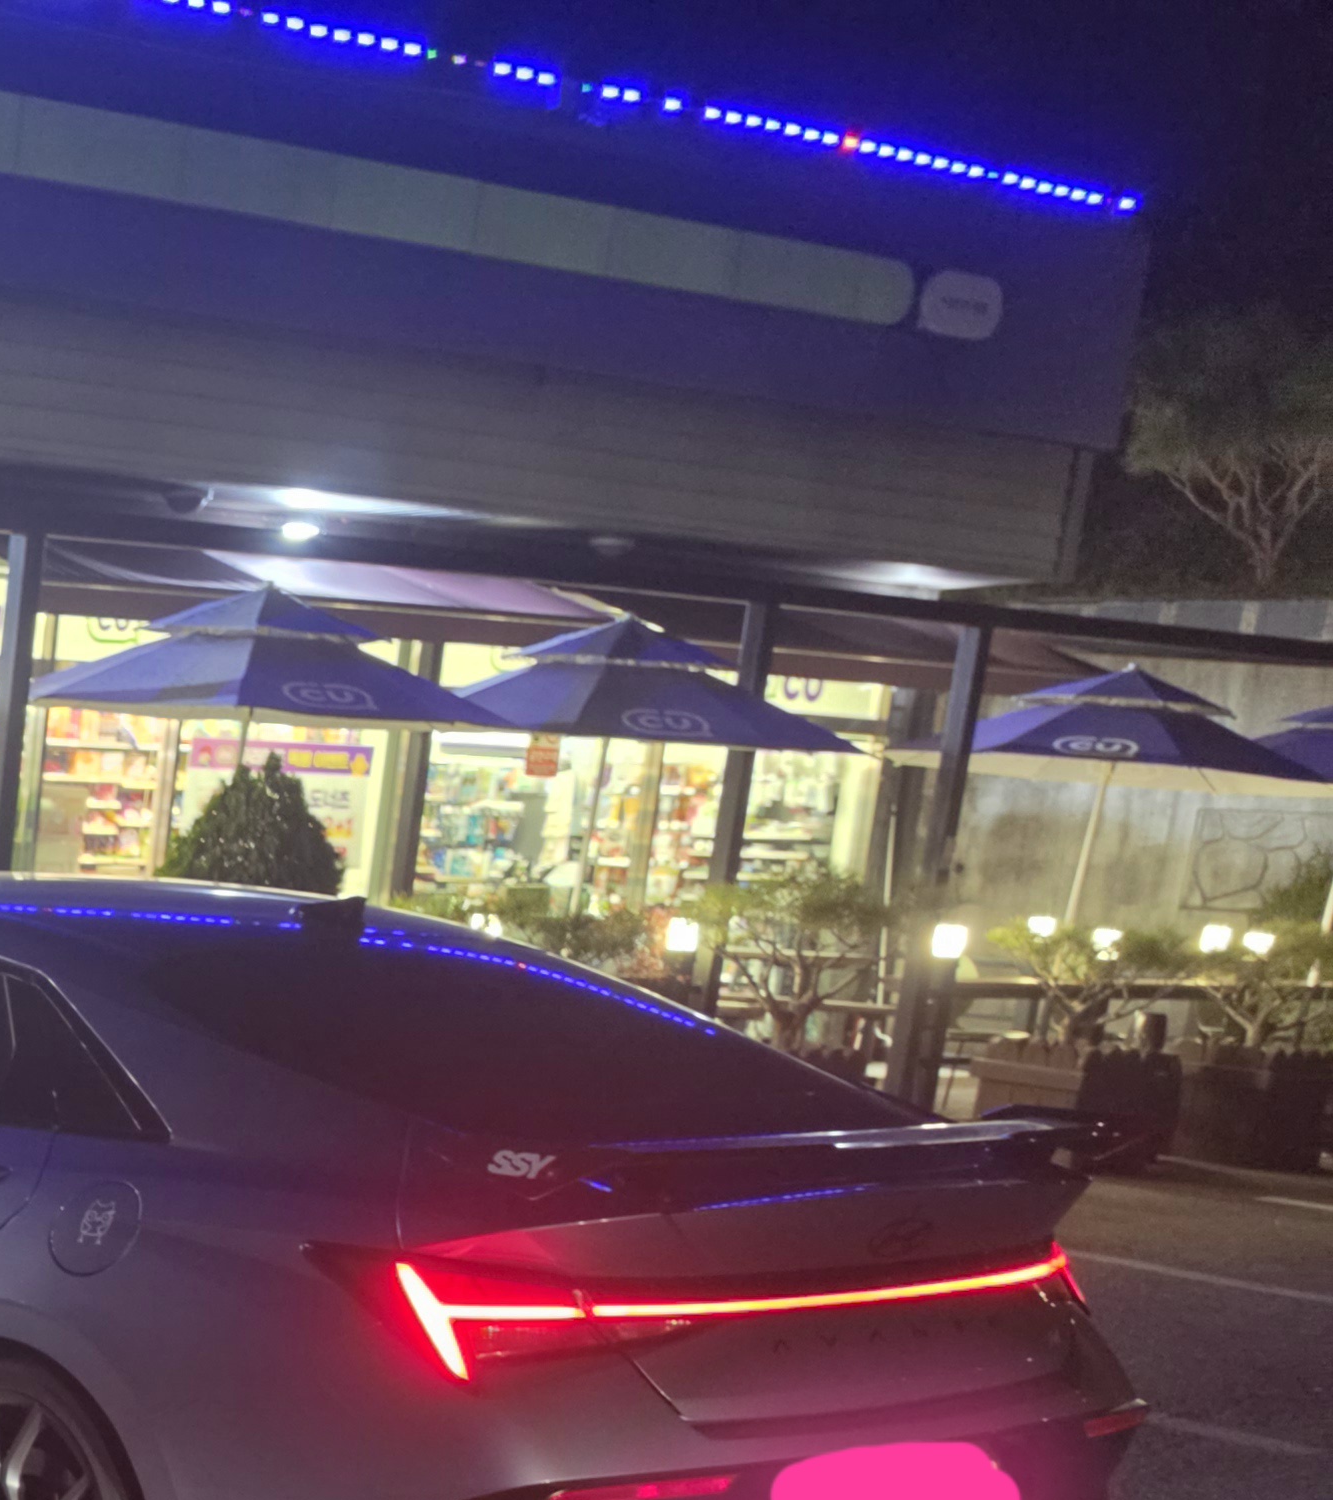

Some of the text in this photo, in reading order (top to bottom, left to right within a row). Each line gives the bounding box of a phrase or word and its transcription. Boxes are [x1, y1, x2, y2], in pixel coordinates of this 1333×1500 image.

[299, 687, 355, 704] CU
[637, 715, 693, 730] CU
[486, 1148, 558, 1180] SSY
